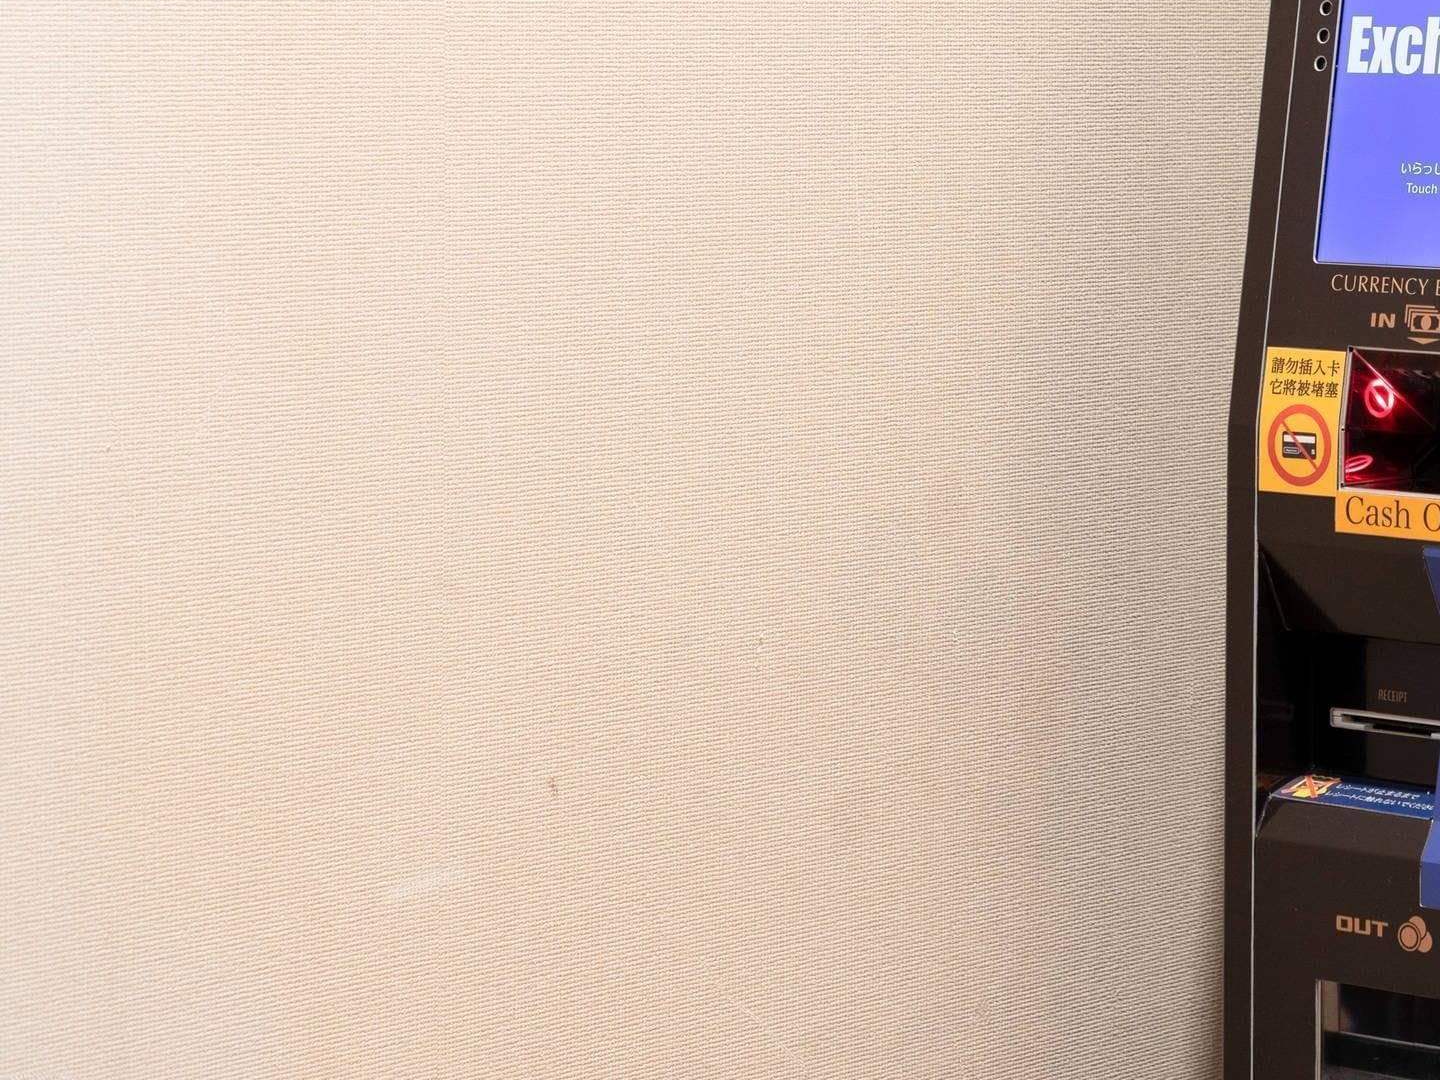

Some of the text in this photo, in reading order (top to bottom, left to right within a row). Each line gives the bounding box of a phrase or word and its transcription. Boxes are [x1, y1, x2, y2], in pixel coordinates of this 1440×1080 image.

[1406, 182, 1438, 195] Touch
[1331, 274, 1429, 296] CURRENCY
[1370, 312, 1396, 328] IN
[1271, 357, 1340, 376] 請勿插入卡
[1270, 380, 1338, 398] 它將被堵塞
[1345, 495, 1412, 530] Cash
[1378, 688, 1407, 703] RECEIPT
[1336, 915, 1388, 938] OUT
